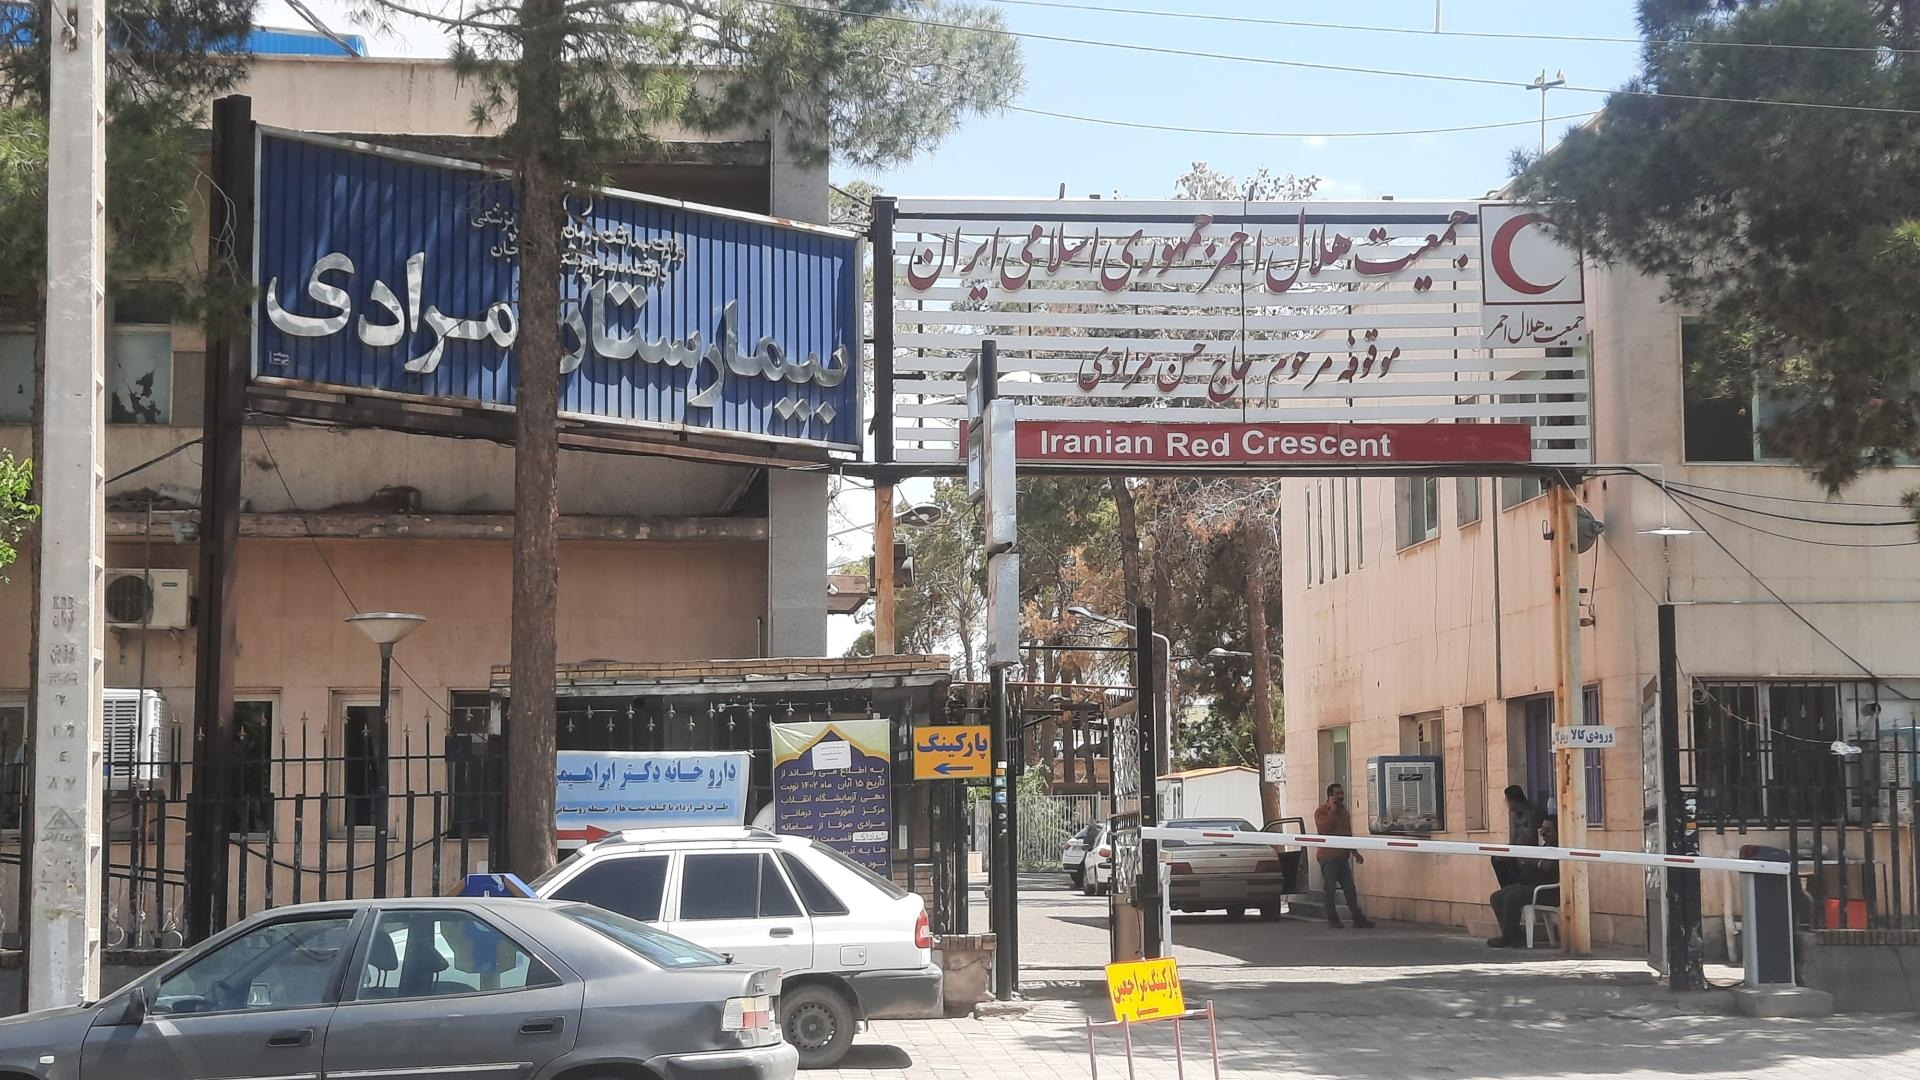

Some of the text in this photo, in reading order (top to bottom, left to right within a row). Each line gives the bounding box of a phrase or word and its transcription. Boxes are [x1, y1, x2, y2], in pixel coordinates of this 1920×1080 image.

[471, 202, 685, 261] وزارت بهداشت درمان پزشکی
[560, 244, 669, 282] دانشکده علوم پزشک
[907, 206, 1470, 301] جمعیت هلال احمر جمهوری اسلامی ایران
[266, 251, 519, 374] مرادی
[1486, 310, 1585, 346] جمعیت هلال احمر
[1076, 328, 1401, 410] موقوفه مرحوم حاج حسن مرادی
[1040, 429, 1392, 458] Iranian Red Crescent
[1570, 728, 1586, 740] کالا
[1585, 731, 1614, 744] ورودی
[916, 731, 989, 760] پارکینگ
[556, 759, 616, 790] ابراهیم
[619, 760, 661, 789] دکتر
[780, 766, 885, 779] به اطلاع می رساند از
[837, 777, 853, 790] آبان
[866, 775, 885, 790] تاریخ
[780, 782, 800, 792] نوبت
[820, 780, 833, 788] ماه
[780, 791, 885, 806] دهی آزمایشگاه انقلاب
[781, 805, 886, 820] مرکز آموزشی درمانی
[781, 818, 886, 831] مرادی صرفا از سامانه
[872, 845, 886, 853] ها
[1112, 965, 1179, 1004] پارکینگ مراجعین
